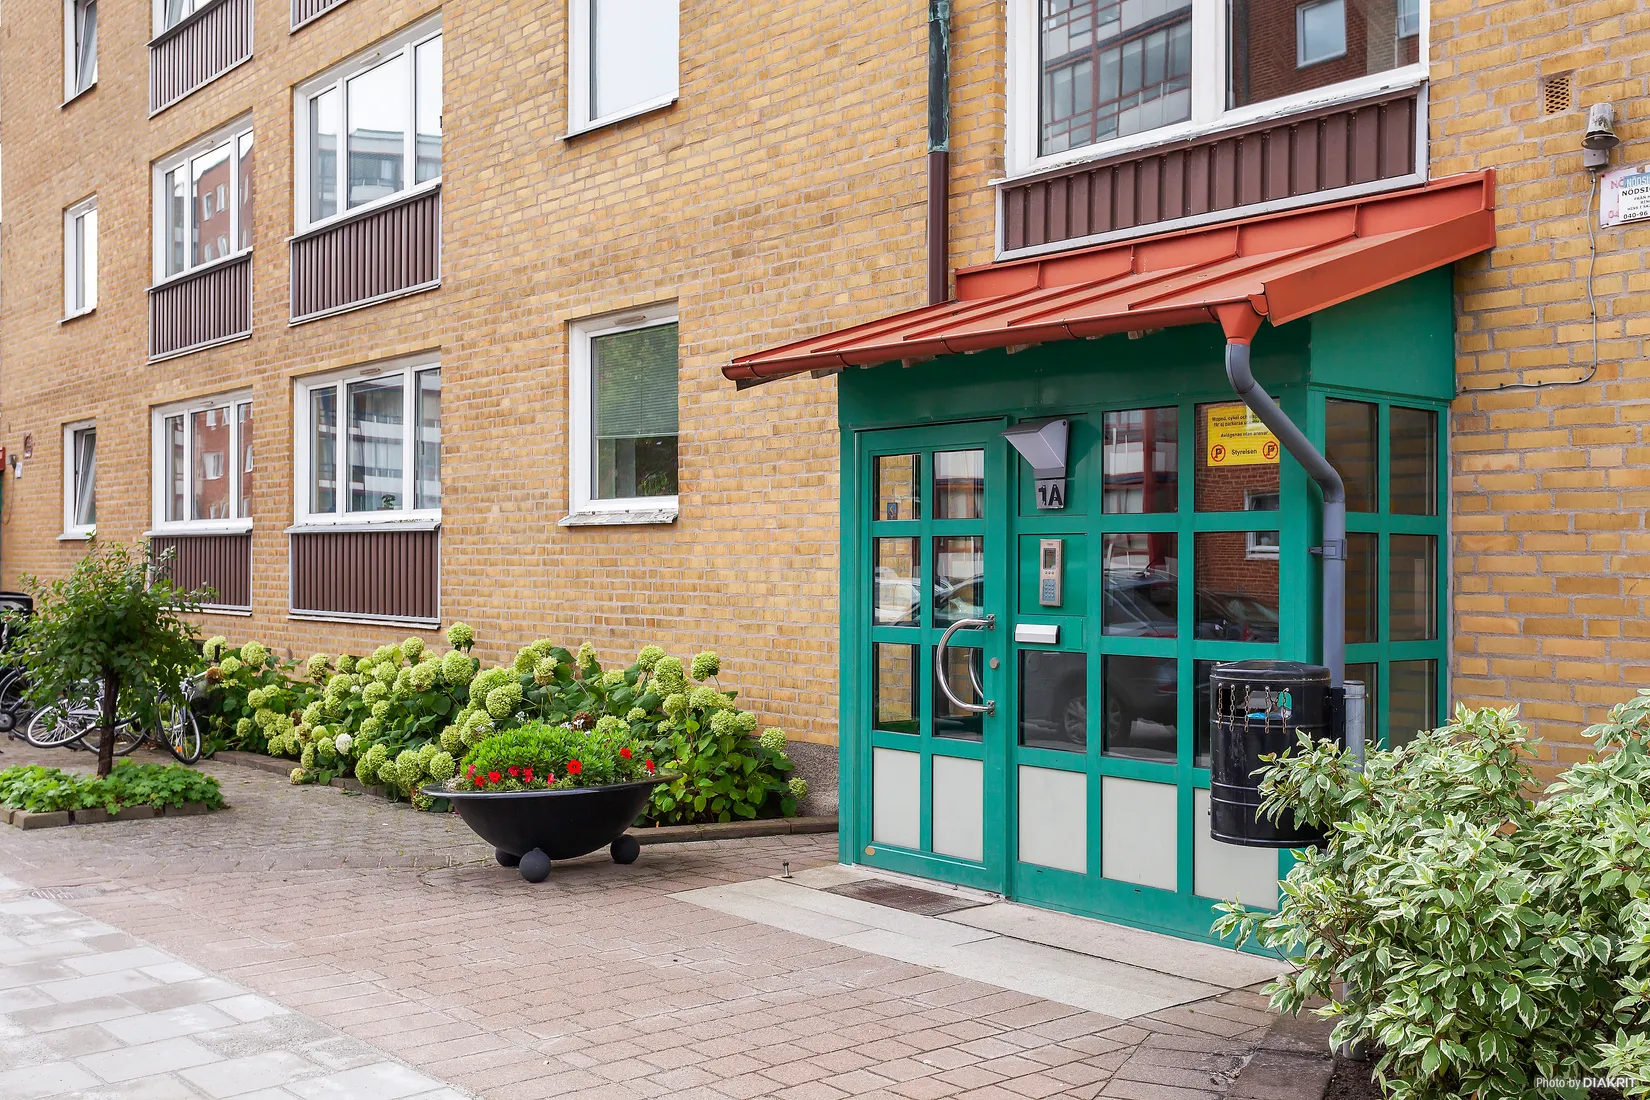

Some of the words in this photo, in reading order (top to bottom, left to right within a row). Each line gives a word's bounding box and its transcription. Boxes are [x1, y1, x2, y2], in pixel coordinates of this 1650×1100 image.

[1622, 186, 1650, 196] NÖDSI
[1624, 210, 1648, 219] 040-96
[1038, 484, 1063, 506] 1A
